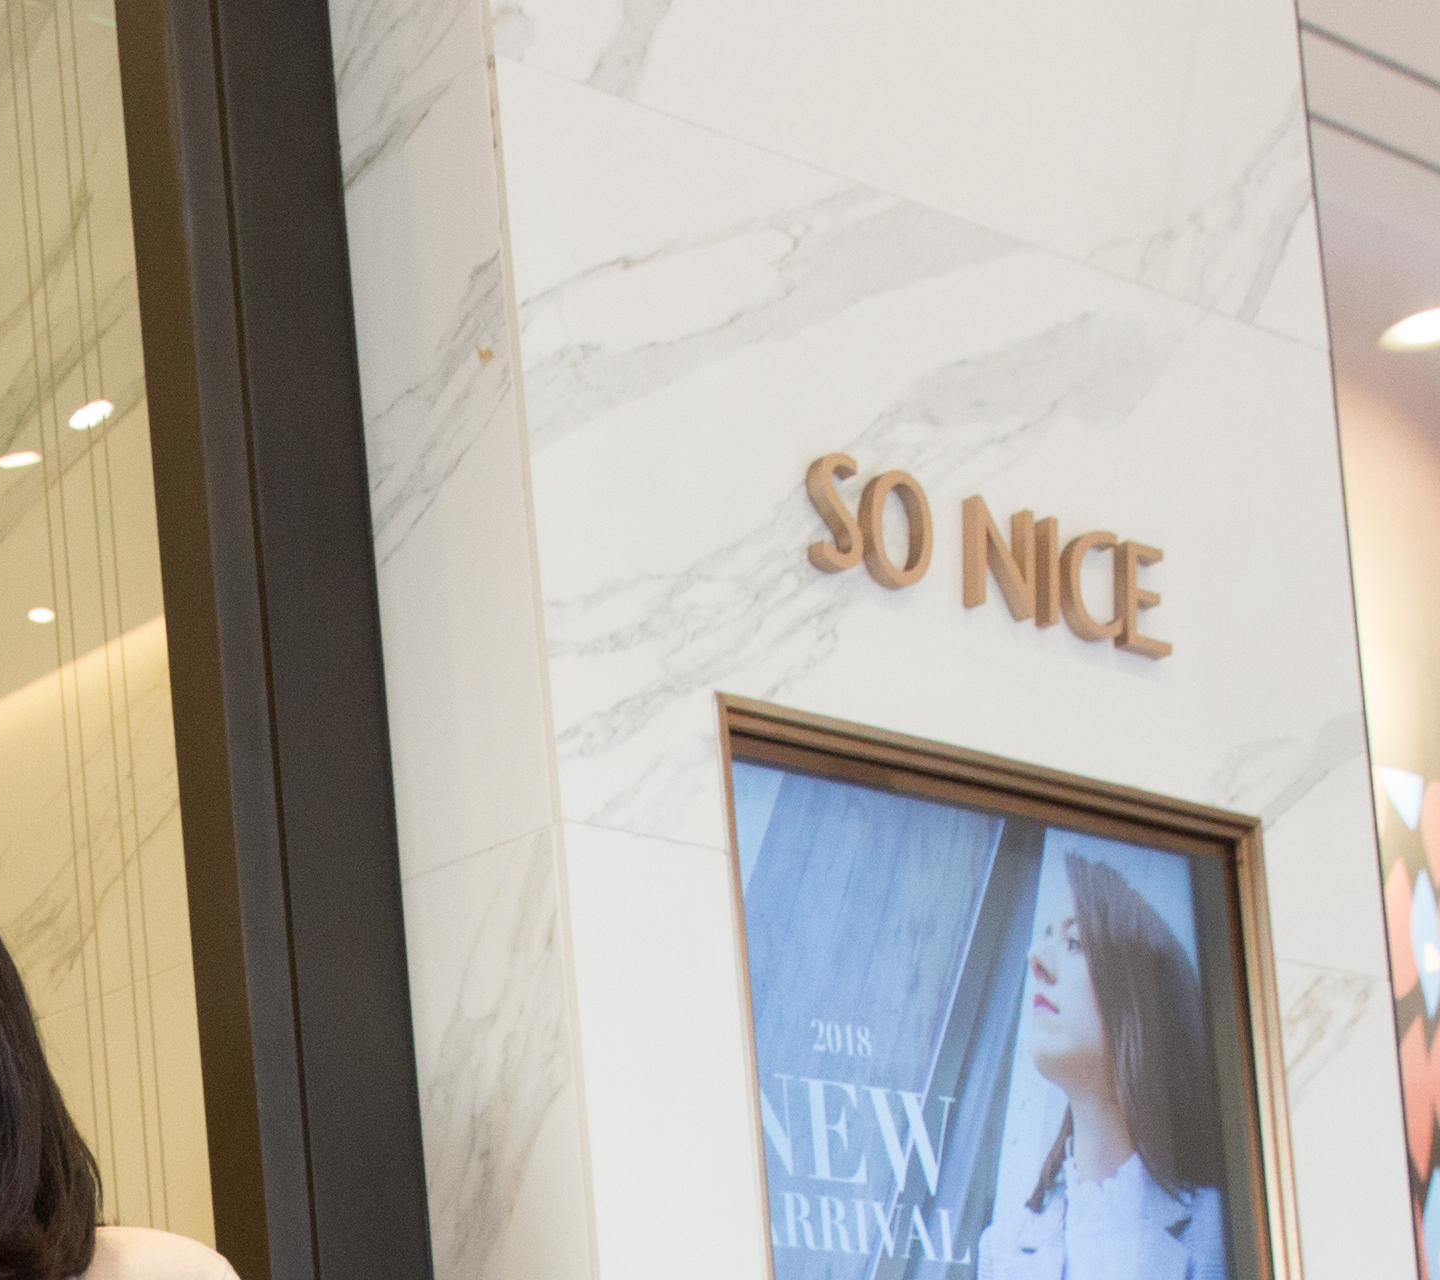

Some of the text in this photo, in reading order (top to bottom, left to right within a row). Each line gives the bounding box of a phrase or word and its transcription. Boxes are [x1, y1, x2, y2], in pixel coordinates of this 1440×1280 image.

[805, 452, 1173, 661] SO NICE
[810, 1018, 873, 1058] 2018
[759, 1073, 956, 1197] NEW
